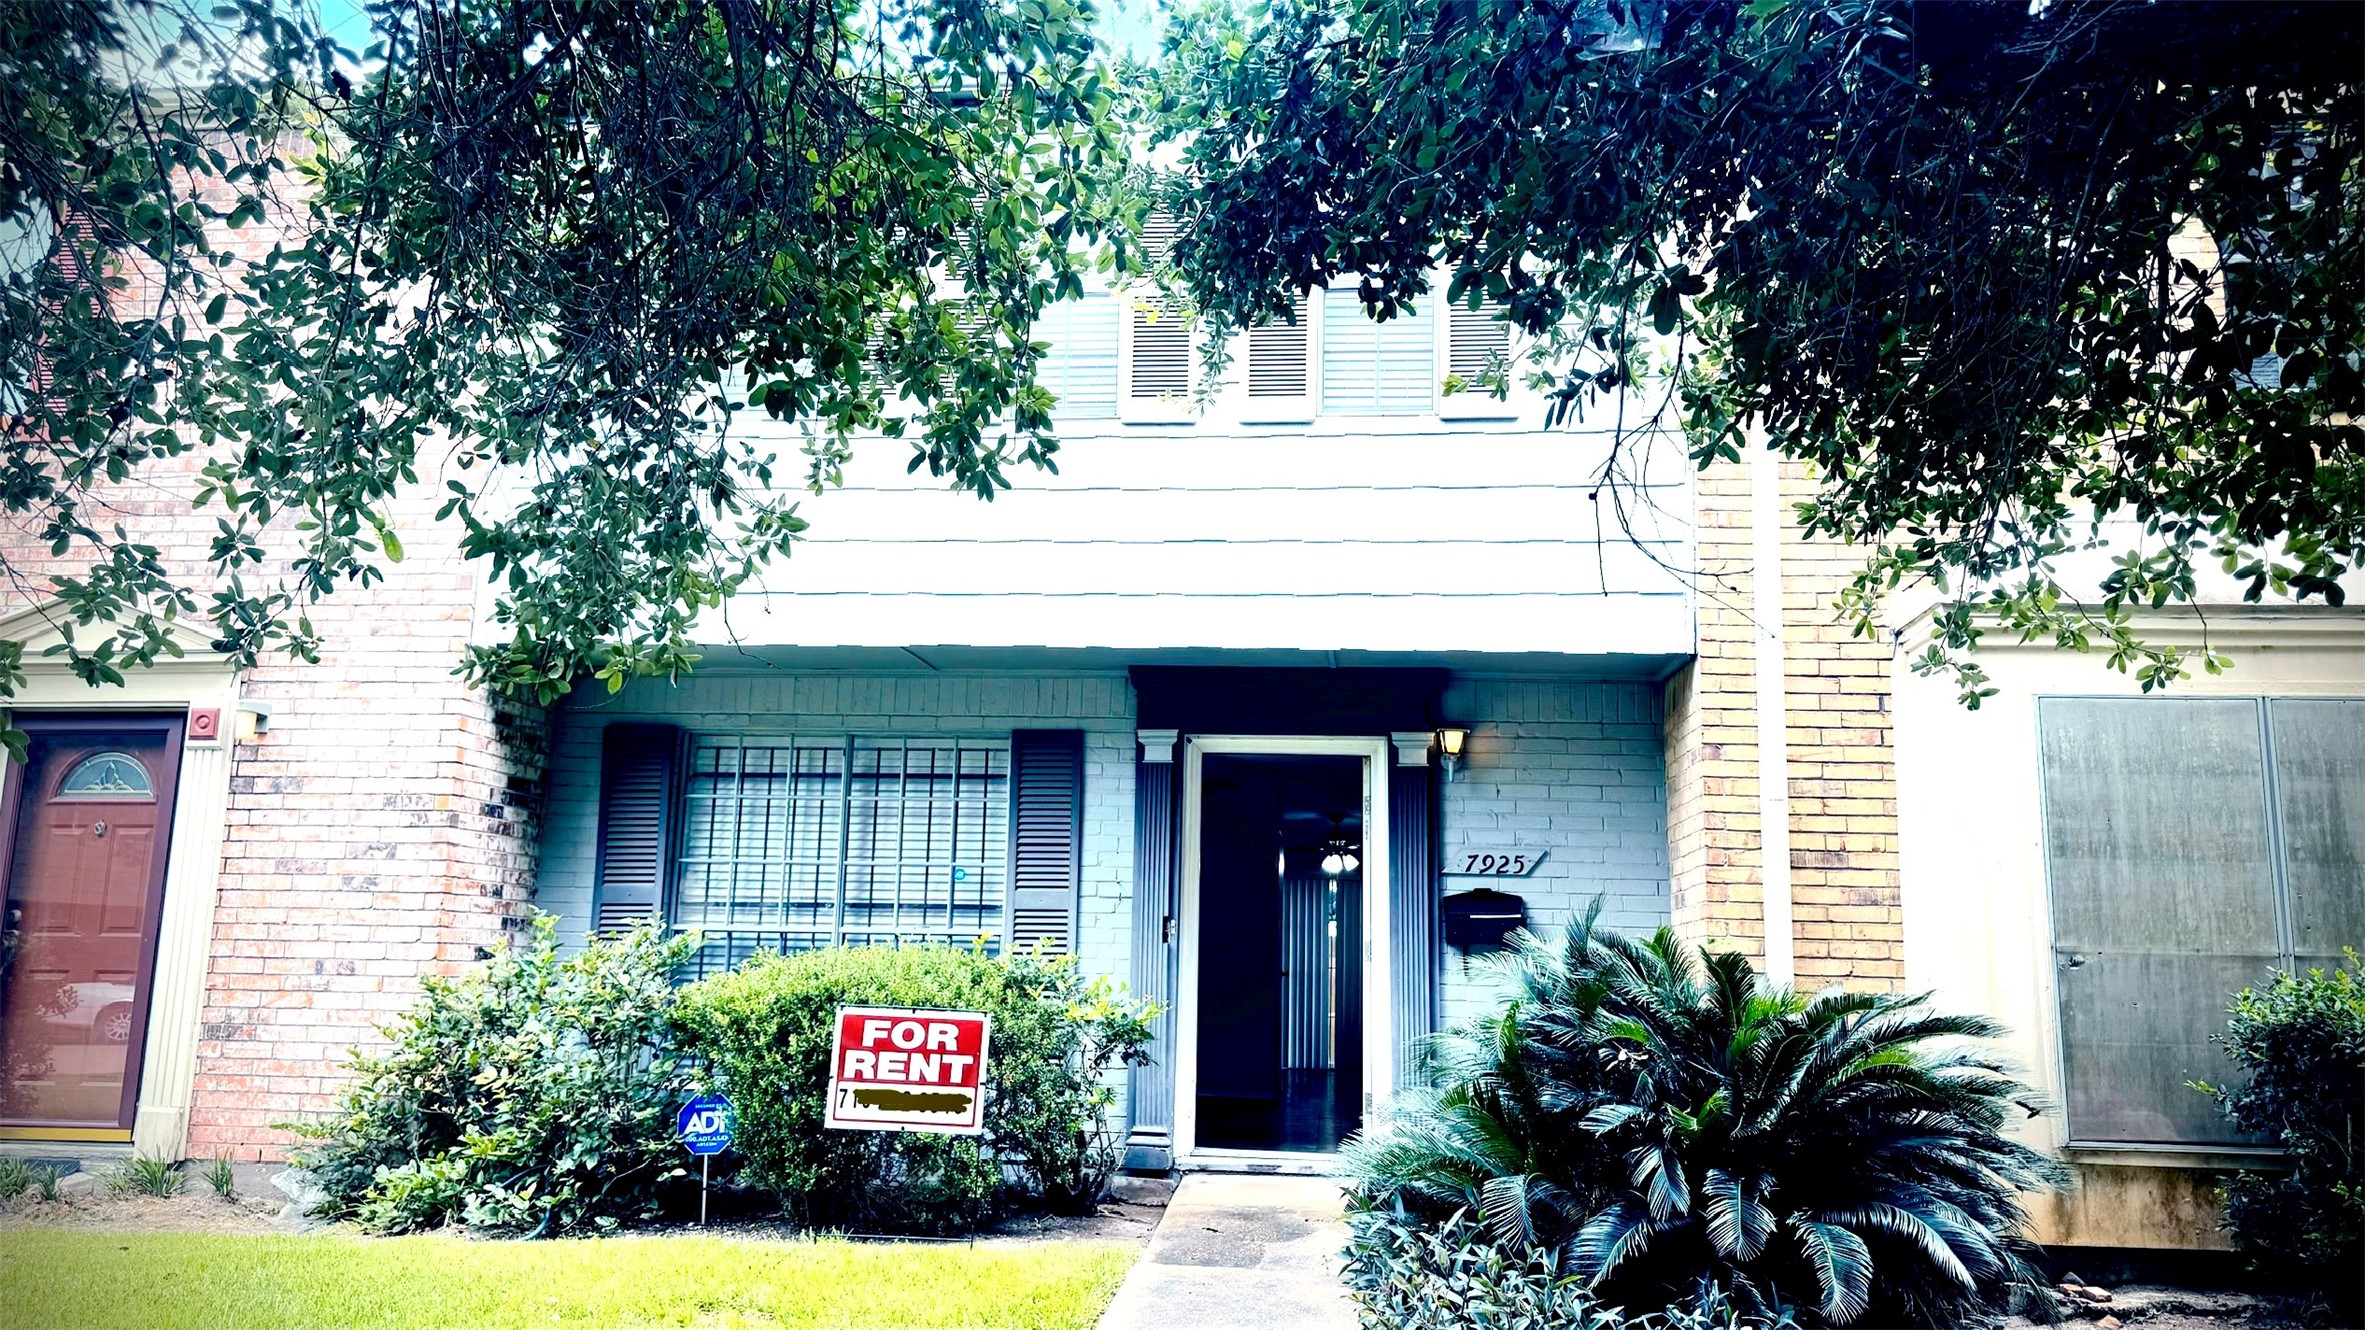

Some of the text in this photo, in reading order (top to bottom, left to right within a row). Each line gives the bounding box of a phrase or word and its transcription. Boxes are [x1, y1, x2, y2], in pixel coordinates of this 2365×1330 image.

[1465, 854, 1525, 874] 7925
[862, 1019, 960, 1051] FOR
[843, 1049, 974, 1084] RENT
[683, 1111, 728, 1134] ADT
